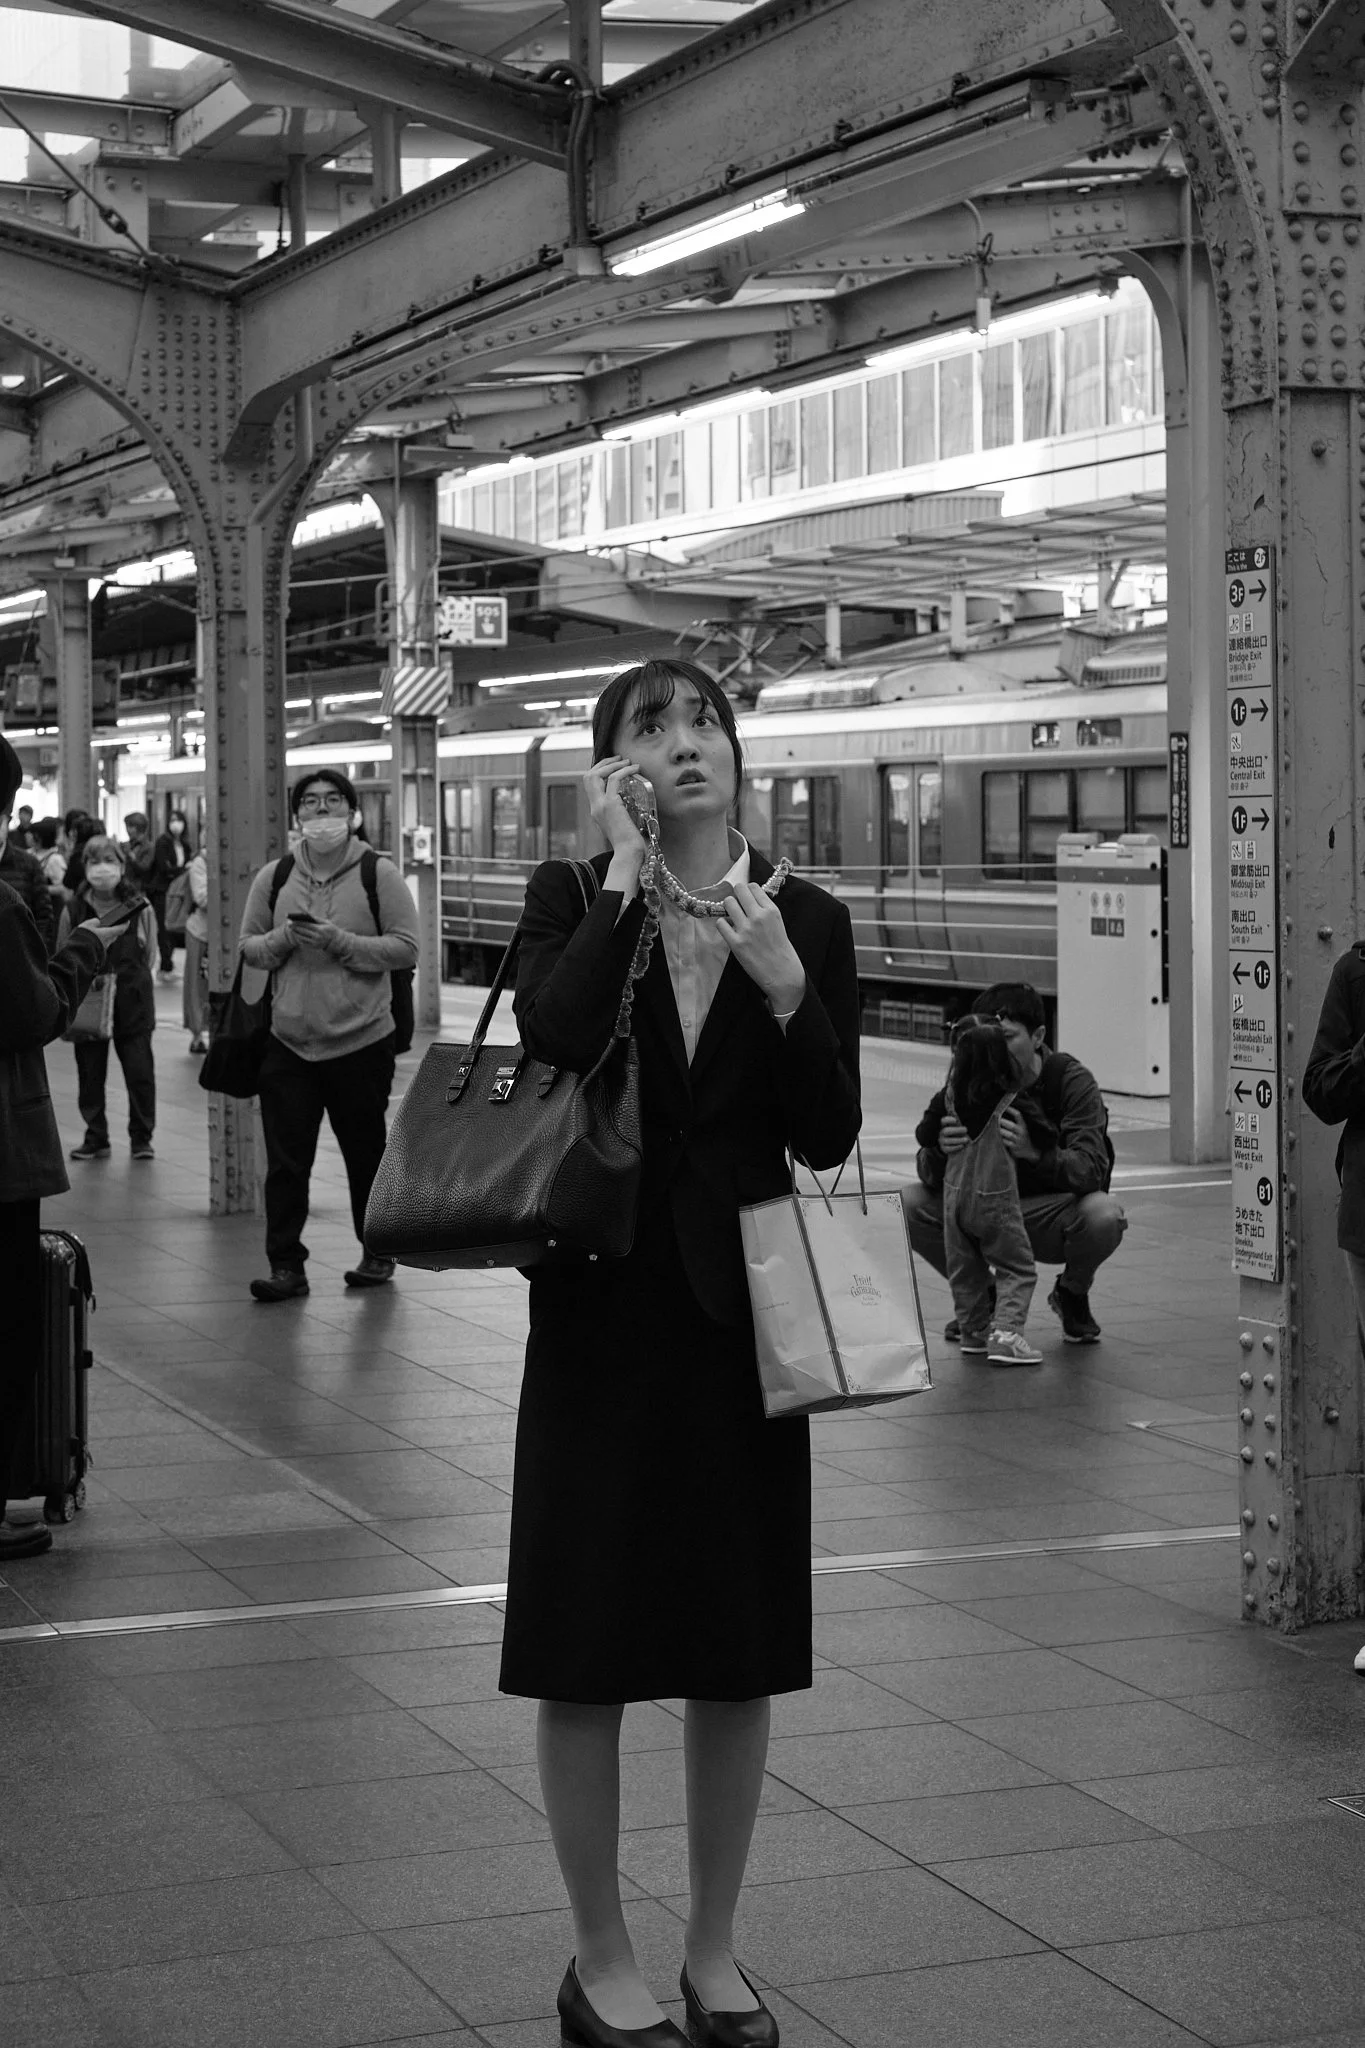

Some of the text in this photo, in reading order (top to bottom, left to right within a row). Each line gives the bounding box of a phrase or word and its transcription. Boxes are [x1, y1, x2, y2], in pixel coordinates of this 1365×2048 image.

[1228, 552, 1246, 562] ここは
[1231, 585, 1244, 602] 3F
[476, 606, 500, 617] SOS
[1229, 635, 1267, 650] 連絡橋出口
[1229, 651, 1262, 663] Bridge Exit
[1233, 703, 1245, 720] 1F
[1230, 756, 1262, 768] 中央出口
[1230, 770, 1265, 780] Central Exit
[1234, 811, 1246, 829] 1F
[1231, 864, 1269, 877] 御堂筋出口
[1255, 879, 1265, 888] Exit
[1231, 910, 1255, 922] 南出口
[1231, 924, 1262, 935] South Exit
[1256, 966, 1269, 984] 1F
[1233, 1018, 1265, 1031] 桜橋出口
[1233, 1032, 1272, 1044] Sakurabashi Exit
[1258, 1085, 1270, 1103] 1F
[1234, 1136, 1258, 1149] 西出口
[1234, 1150, 1263, 1162] West Exit
[1259, 1183, 1271, 1201] B1
[1235, 1207, 1263, 1222] うめきた
[1235, 1222, 1264, 1238] 地下出口
[1235, 1247, 1273, 1262] Underground Exit
